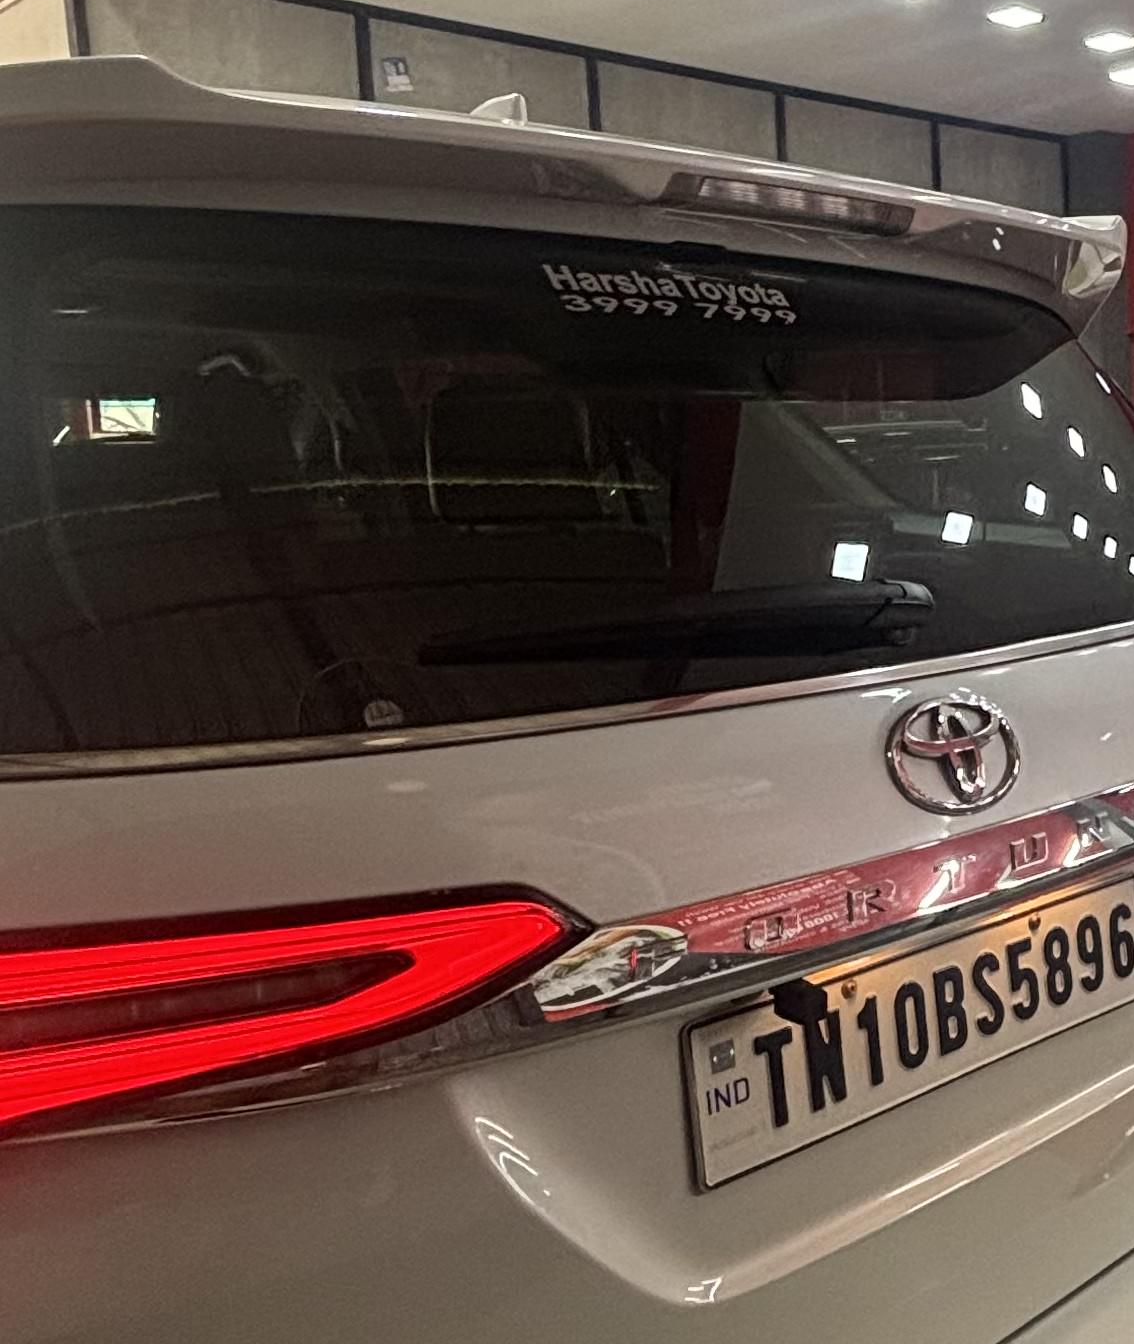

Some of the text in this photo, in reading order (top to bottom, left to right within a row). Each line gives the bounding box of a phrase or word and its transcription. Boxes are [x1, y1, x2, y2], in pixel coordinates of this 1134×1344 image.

[560, 294, 798, 325] 3999 7999
[706, 1077, 750, 1116] IND
